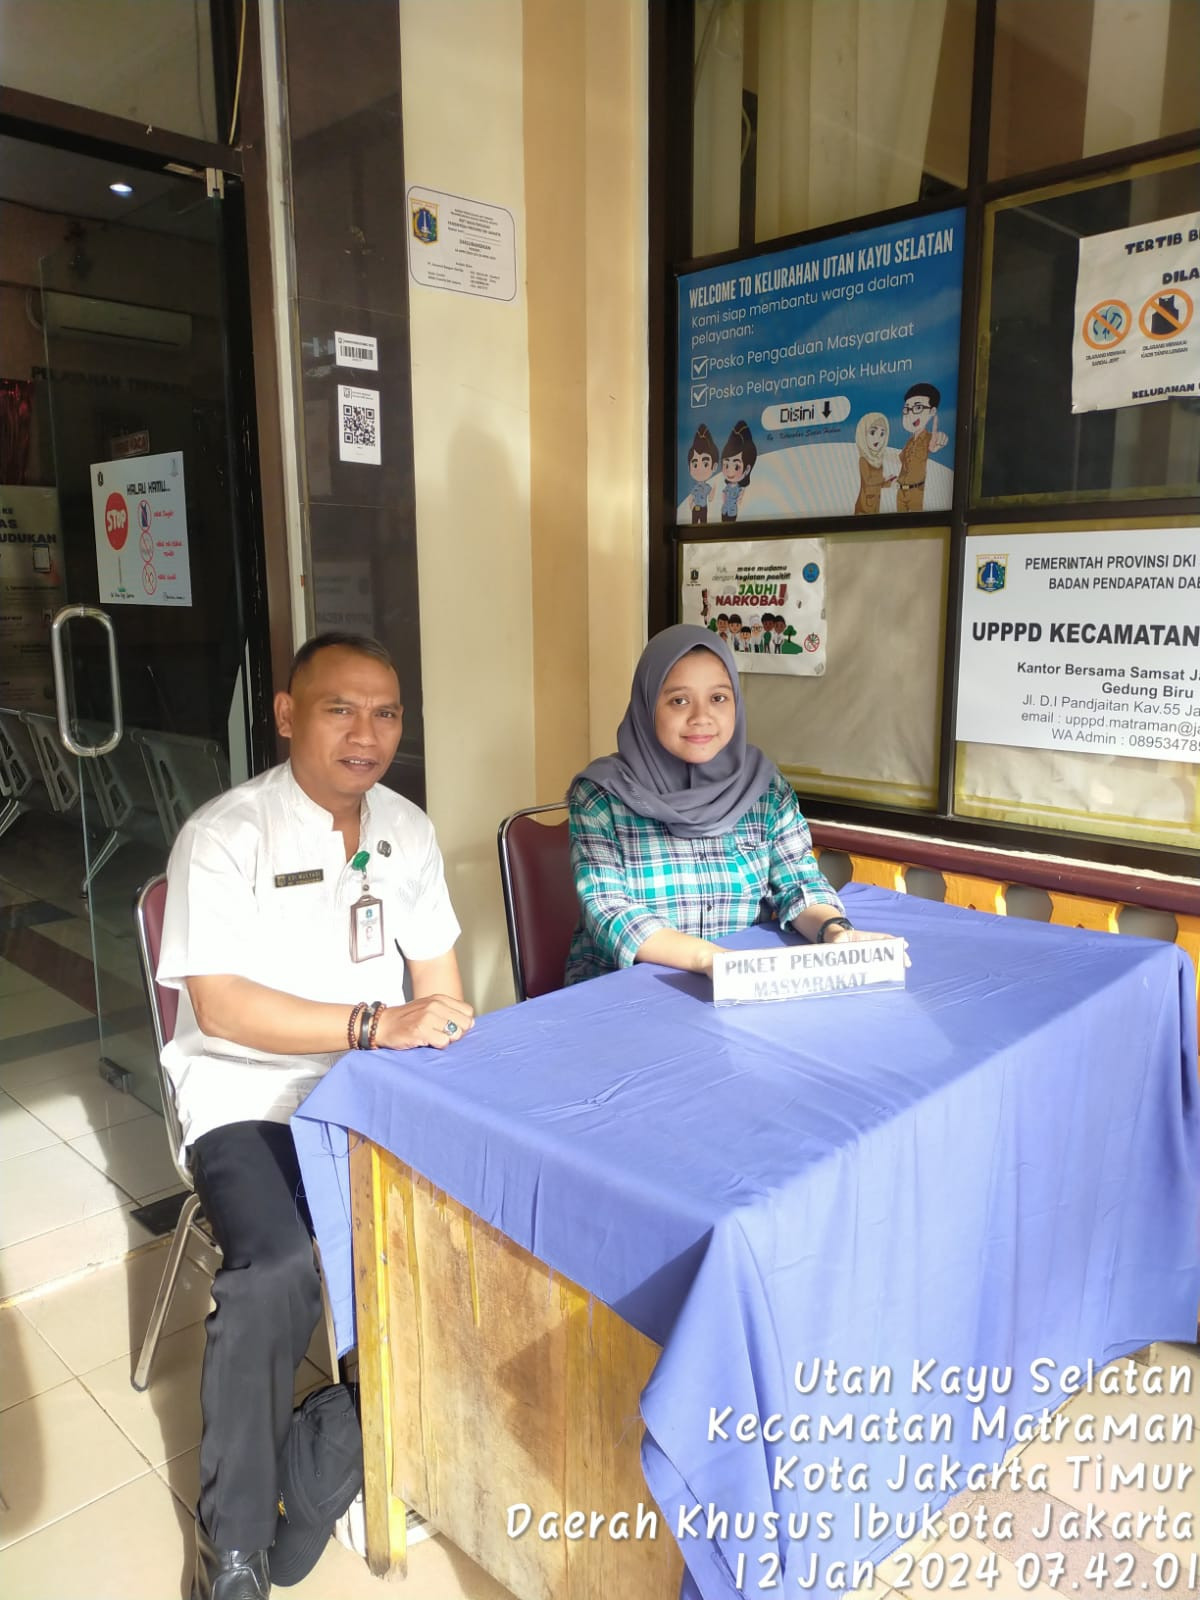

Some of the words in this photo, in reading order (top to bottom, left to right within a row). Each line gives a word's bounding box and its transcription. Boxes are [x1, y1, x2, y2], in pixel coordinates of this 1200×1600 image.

[1124, 232, 1183, 255] TERTIB
[1188, 228, 1200, 242] B
[689, 278, 736, 309] WELCOME
[739, 275, 752, 298] TO
[754, 260, 820, 295] KELURAHAN
[823, 252, 855, 279] UTAN
[857, 243, 891, 272] KAYU
[894, 228, 954, 263] SELATAN
[691, 311, 720, 329] Kami
[722, 307, 746, 326] siap
[750, 292, 818, 316] membantu
[822, 282, 864, 301] warga
[867, 271, 915, 292] dalam
[691, 324, 754, 349] pelayanan:
[709, 354, 744, 371] Posko
[747, 339, 823, 365] Pengaduan
[827, 322, 914, 350] Masyarakat
[709, 383, 743, 400] Posko
[747, 369, 815, 394] Pelayanan
[819, 362, 855, 386] Pojok
[860, 358, 912, 377] Hukum
[780, 404, 814, 424] Disini
[106, 509, 127, 532] STOP
[1025, 556, 1102, 570] PEMERINTAH
[1107, 555, 1169, 569] PROVINSI
[1173, 554, 1196, 568] DKI
[1049, 577, 1090, 590] BADAN
[1093, 576, 1175, 590] PENDAPATAN
[972, 622, 1043, 643] UPPPD
[1050, 623, 1200, 647] KECAMATAN
[1016, 662, 1061, 675] Kantor
[1064, 664, 1126, 678] Bersama
[1130, 666, 1185, 681] Samsat
[1101, 682, 1158, 699] Gedung
[1163, 685, 1194, 699] Biru
[1022, 694, 1036, 706] Jl.
[1039, 695, 1057, 707] D.I
[1061, 697, 1129, 713] Pandjaitan
[1134, 701, 1180, 716] Kav.55
[1021, 711, 1054, 724] email
[1051, 728, 1074, 741] WA
[1075, 730, 1117, 745] Admin
[725, 956, 777, 975] PIKET
[790, 946, 895, 970] PENGADUAN
[754, 972, 868, 998] MASYARAKAT
